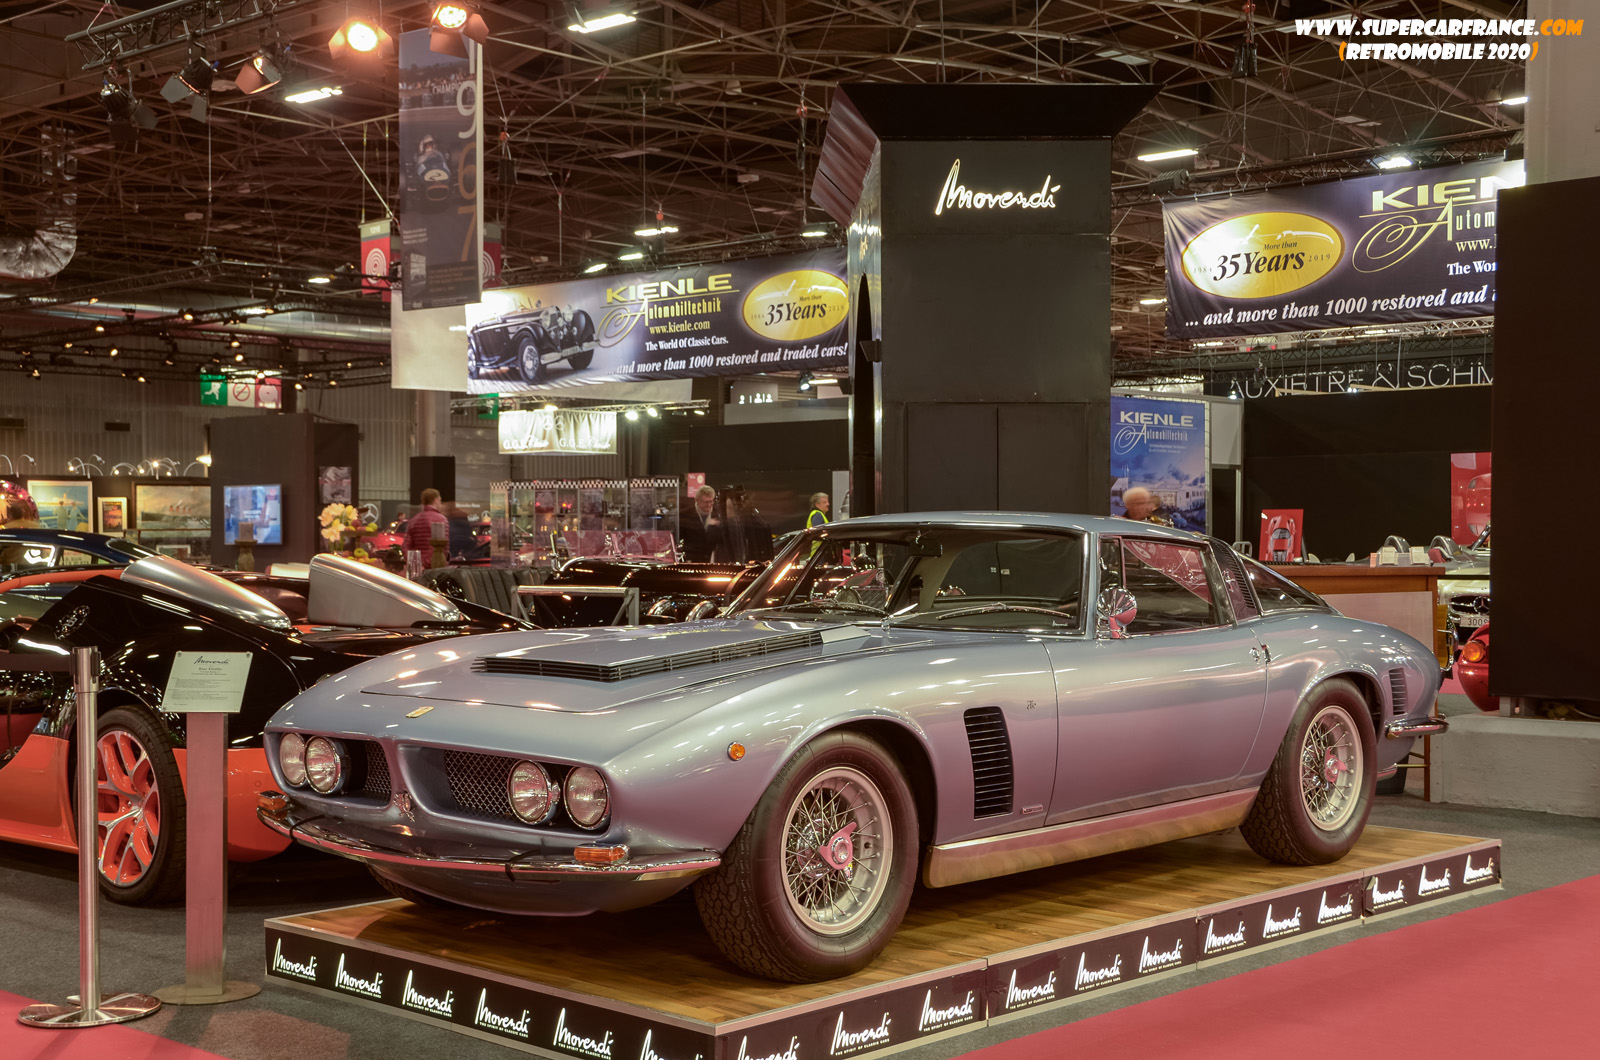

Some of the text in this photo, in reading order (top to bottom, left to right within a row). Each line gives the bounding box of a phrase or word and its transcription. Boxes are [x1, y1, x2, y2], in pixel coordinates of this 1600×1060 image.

[935, 158, 1061, 216] Movendi
[1263, 243, 1280, 251] More
[606, 273, 732, 304] KIENLE
[1447, 262, 1471, 276] The
[1203, 307, 1233, 325] and
[1236, 307, 1278, 323] more
[1282, 302, 1320, 319] than
[1325, 297, 1368, 316] 1000
[1371, 288, 1446, 312] restored
[1451, 284, 1489, 305] and
[645, 335, 729, 351] The World Of Classic Cars.
[649, 320, 711, 335] www.kienle.com
[616, 361, 636, 374] and
[636, 361, 661, 373] more
[663, 357, 686, 371] than
[688, 354, 714, 369] 1000
[716, 349, 758, 366] restored
[760, 348, 781, 363] and
[783, 344, 819, 360] traded
[821, 342, 848, 356] cars!
[1120, 411, 1194, 427] KIENLE
[273, 938, 317, 977] Movendi
[335, 953, 383, 994] Movendi
[1074, 951, 1122, 990] Movendi
[1139, 936, 1183, 973] Movendi
[402, 969, 454, 1013] Movendi
[1006, 969, 1056, 1009] Movendi
[475, 988, 530, 1033] Movendi
[919, 989, 974, 1031] Movendi
[553, 1007, 614, 1056] Movendi
[830, 1011, 892, 1055] Movendi
